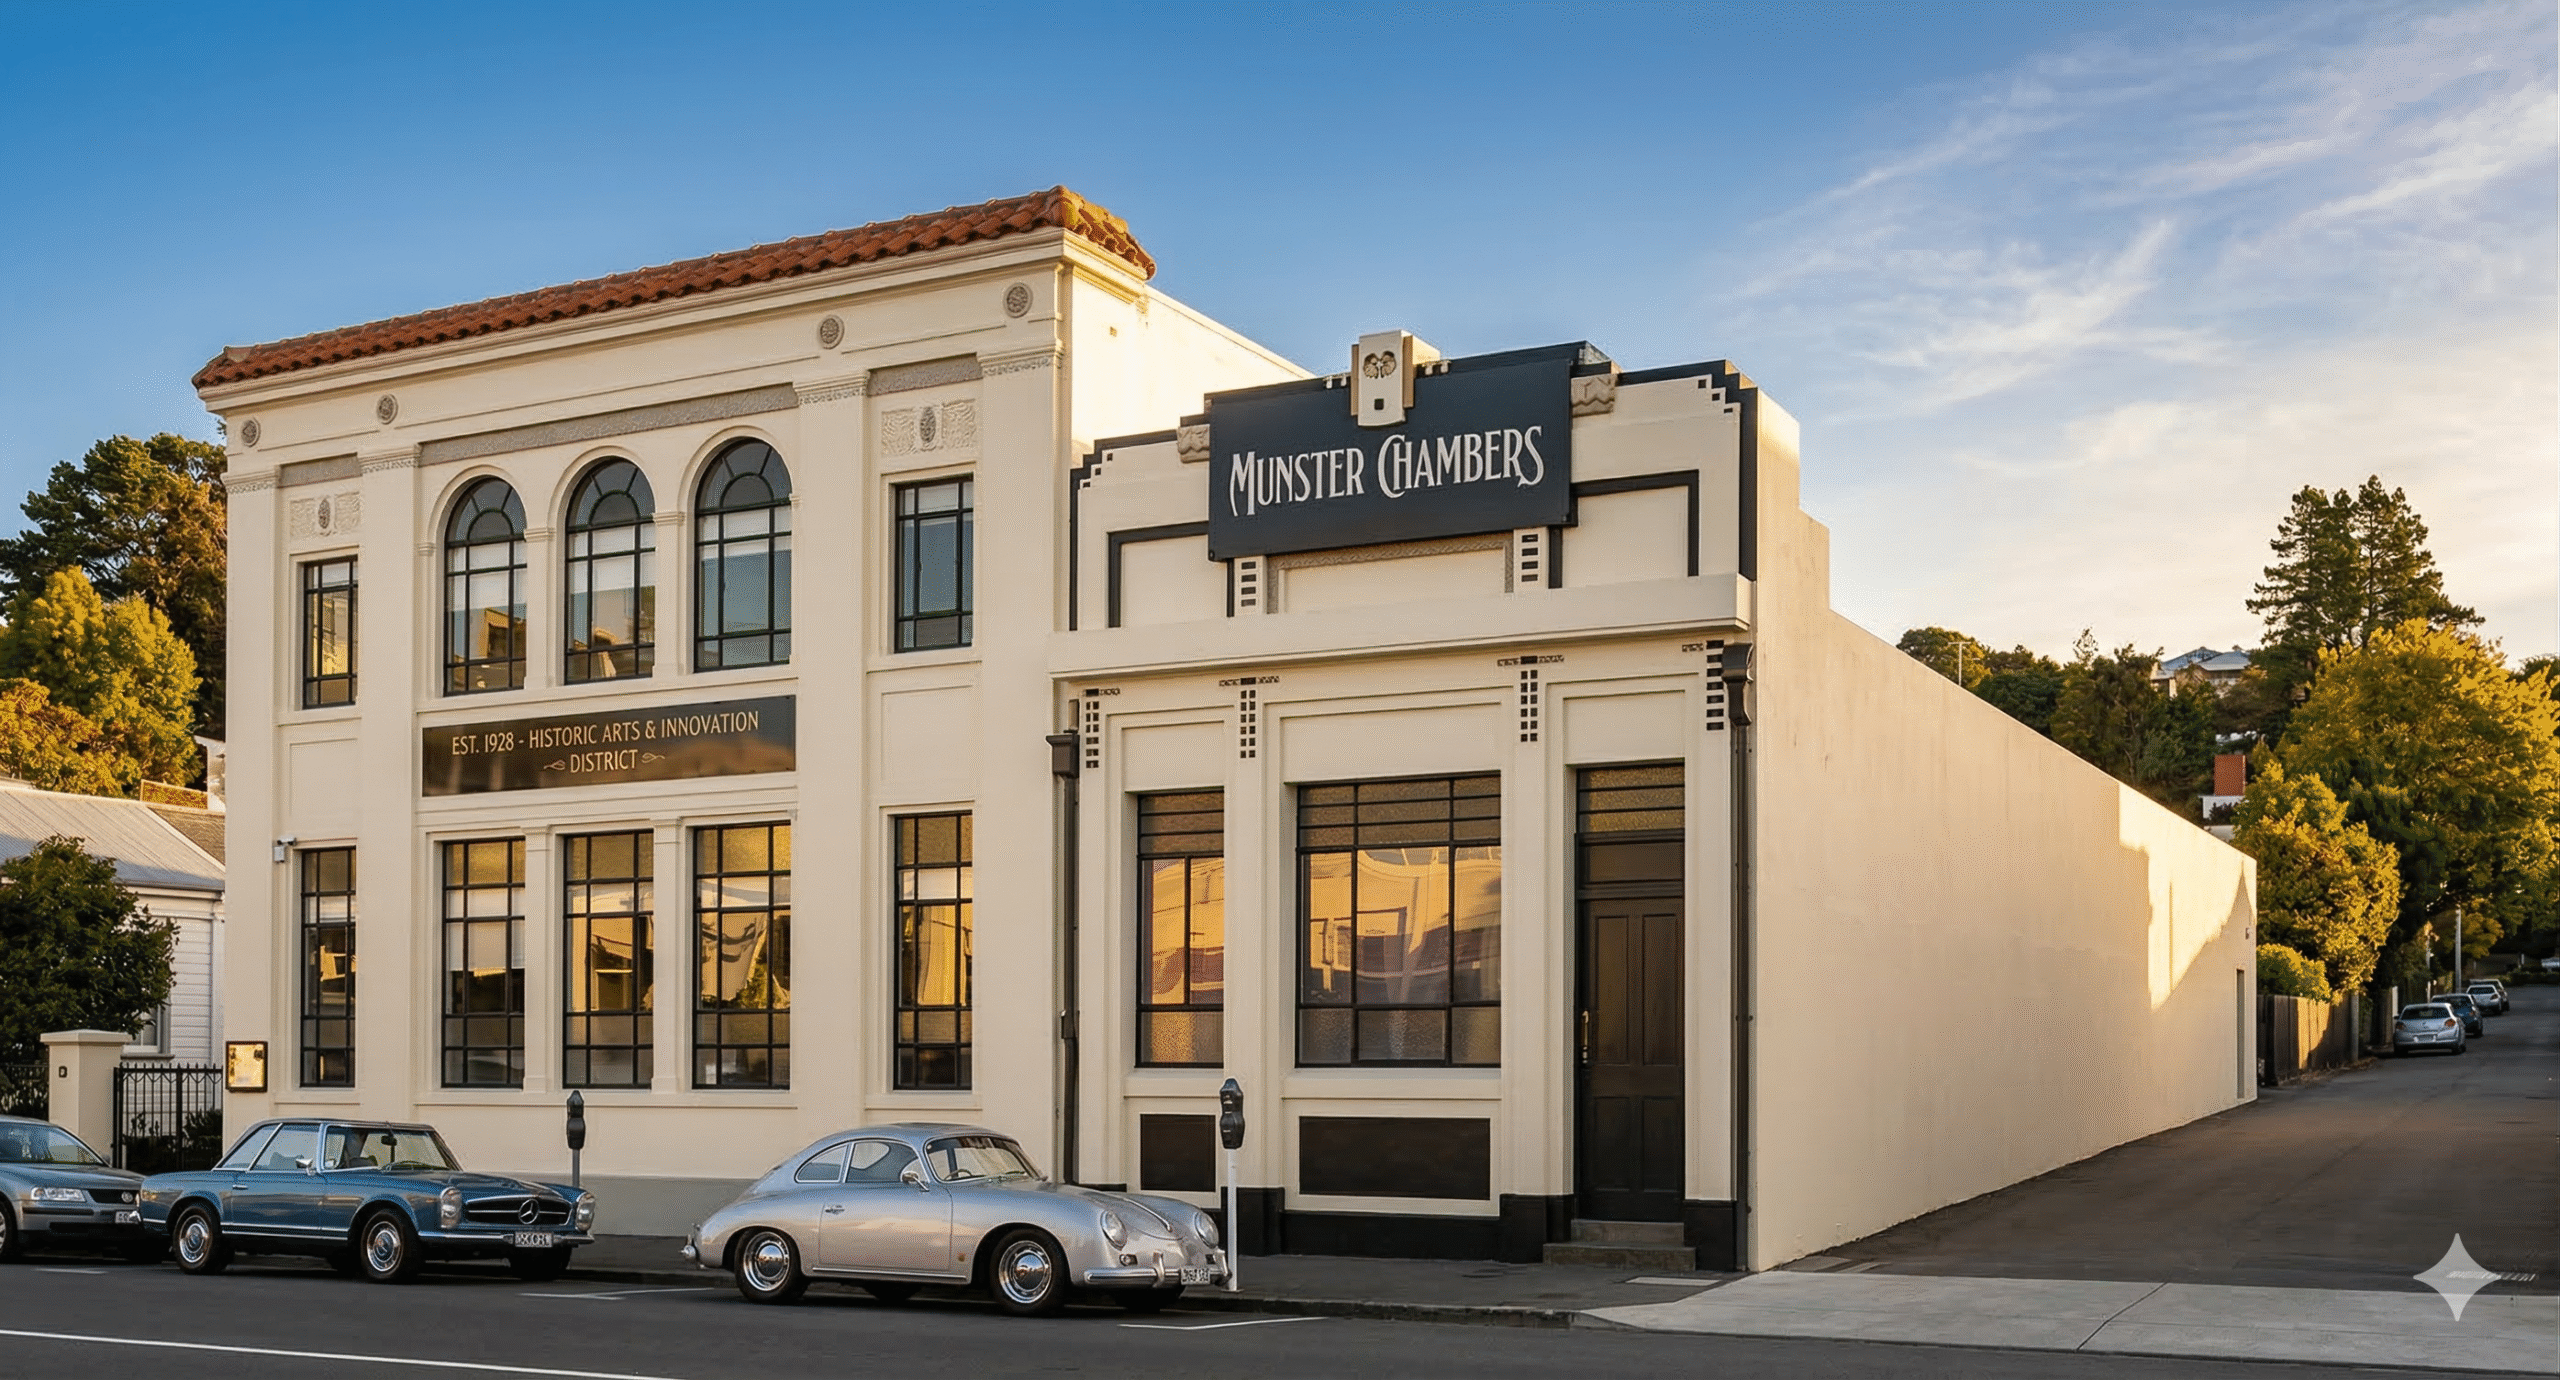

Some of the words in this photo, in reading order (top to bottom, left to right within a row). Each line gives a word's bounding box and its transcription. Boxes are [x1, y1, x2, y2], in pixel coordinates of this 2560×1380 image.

[1229, 448, 1365, 517] MUNSTER
[1377, 425, 1544, 499] CHAMBERS
[452, 735, 479, 755] EST.
[485, 732, 514, 752] 1928
[529, 725, 598, 749] HISTORIC
[602, 721, 640, 743] ARTS
[645, 720, 656, 739] &
[661, 711, 759, 738] INNOVATION
[570, 749, 638, 774] DISTRICT
